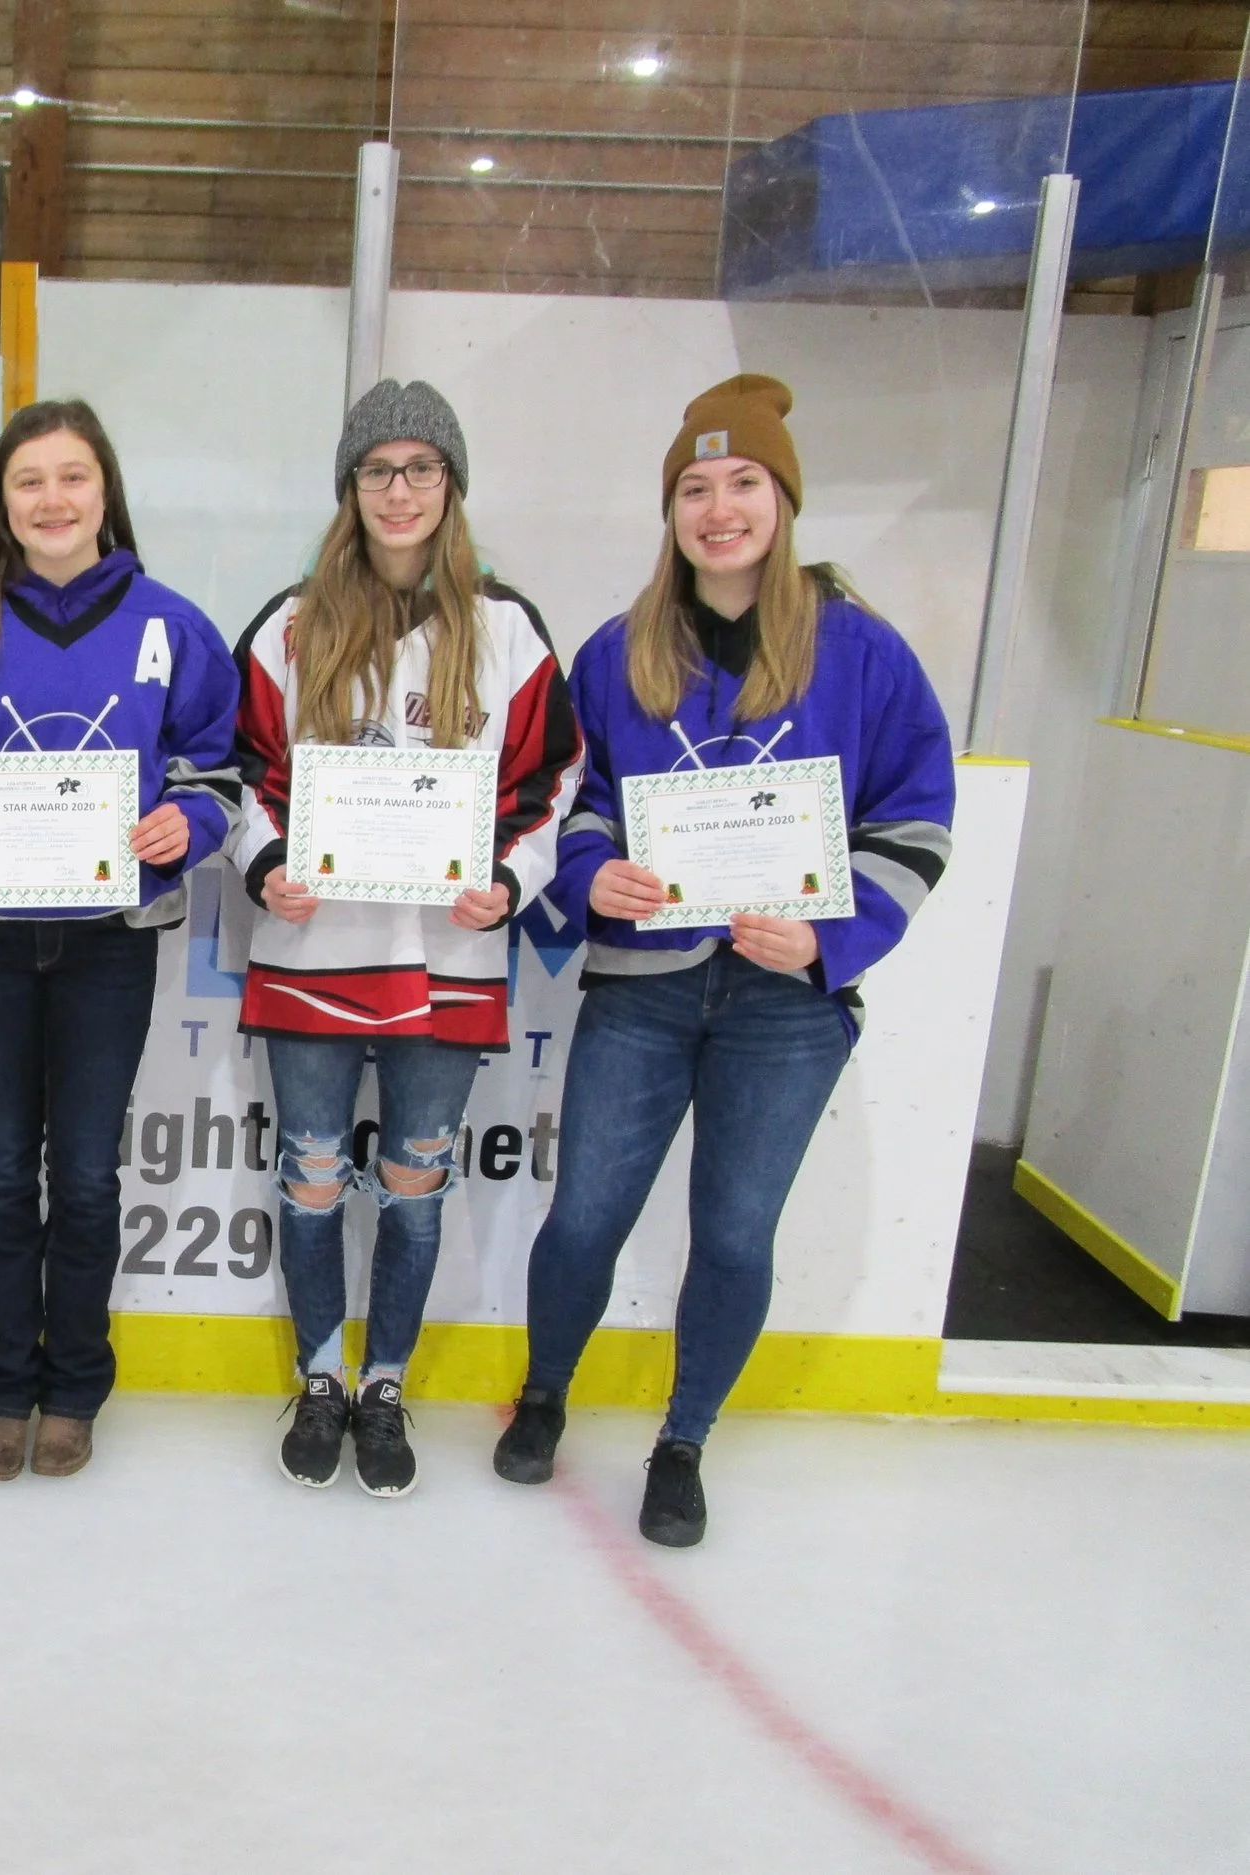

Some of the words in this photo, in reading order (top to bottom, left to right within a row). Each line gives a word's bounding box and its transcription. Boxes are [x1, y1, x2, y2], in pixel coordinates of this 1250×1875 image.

[134, 617, 172, 688] A
[3, 803, 28, 813] STAR
[30, 803, 69, 812] AWARD
[71, 802, 96, 811] 2020
[336, 796, 354, 805] ALL
[356, 797, 381, 807] STAR
[383, 798, 423, 808] AWARD
[425, 799, 451, 809] 2020
[672, 824, 691, 834] ALL
[693, 822, 720, 832] STAR
[723, 818, 765, 830] AWARD
[768, 814, 795, 826] 2020
